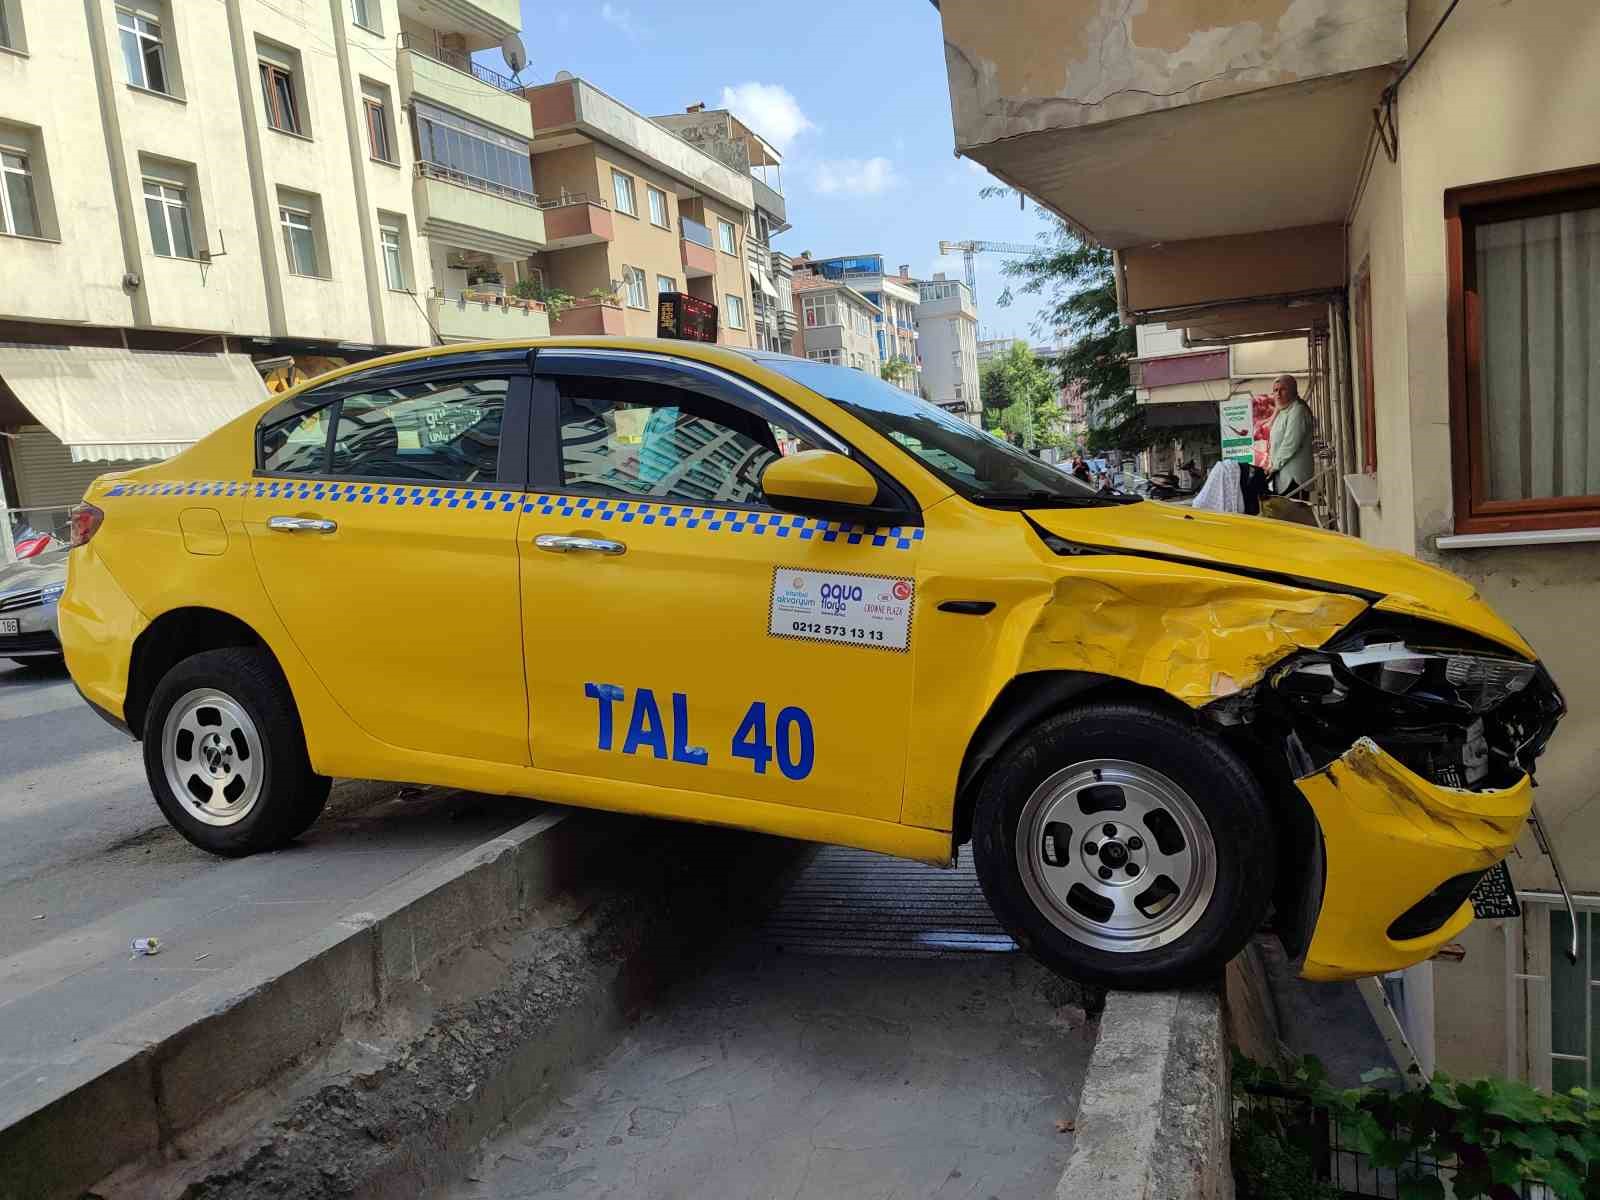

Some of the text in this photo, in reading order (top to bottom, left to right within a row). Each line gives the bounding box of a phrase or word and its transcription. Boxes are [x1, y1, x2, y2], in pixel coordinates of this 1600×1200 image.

[820, 583, 863, 602] aqua
[821, 598, 847, 614] florya
[792, 621, 884, 641] 0212 573 13 13
[584, 682, 815, 781] TAL 40
